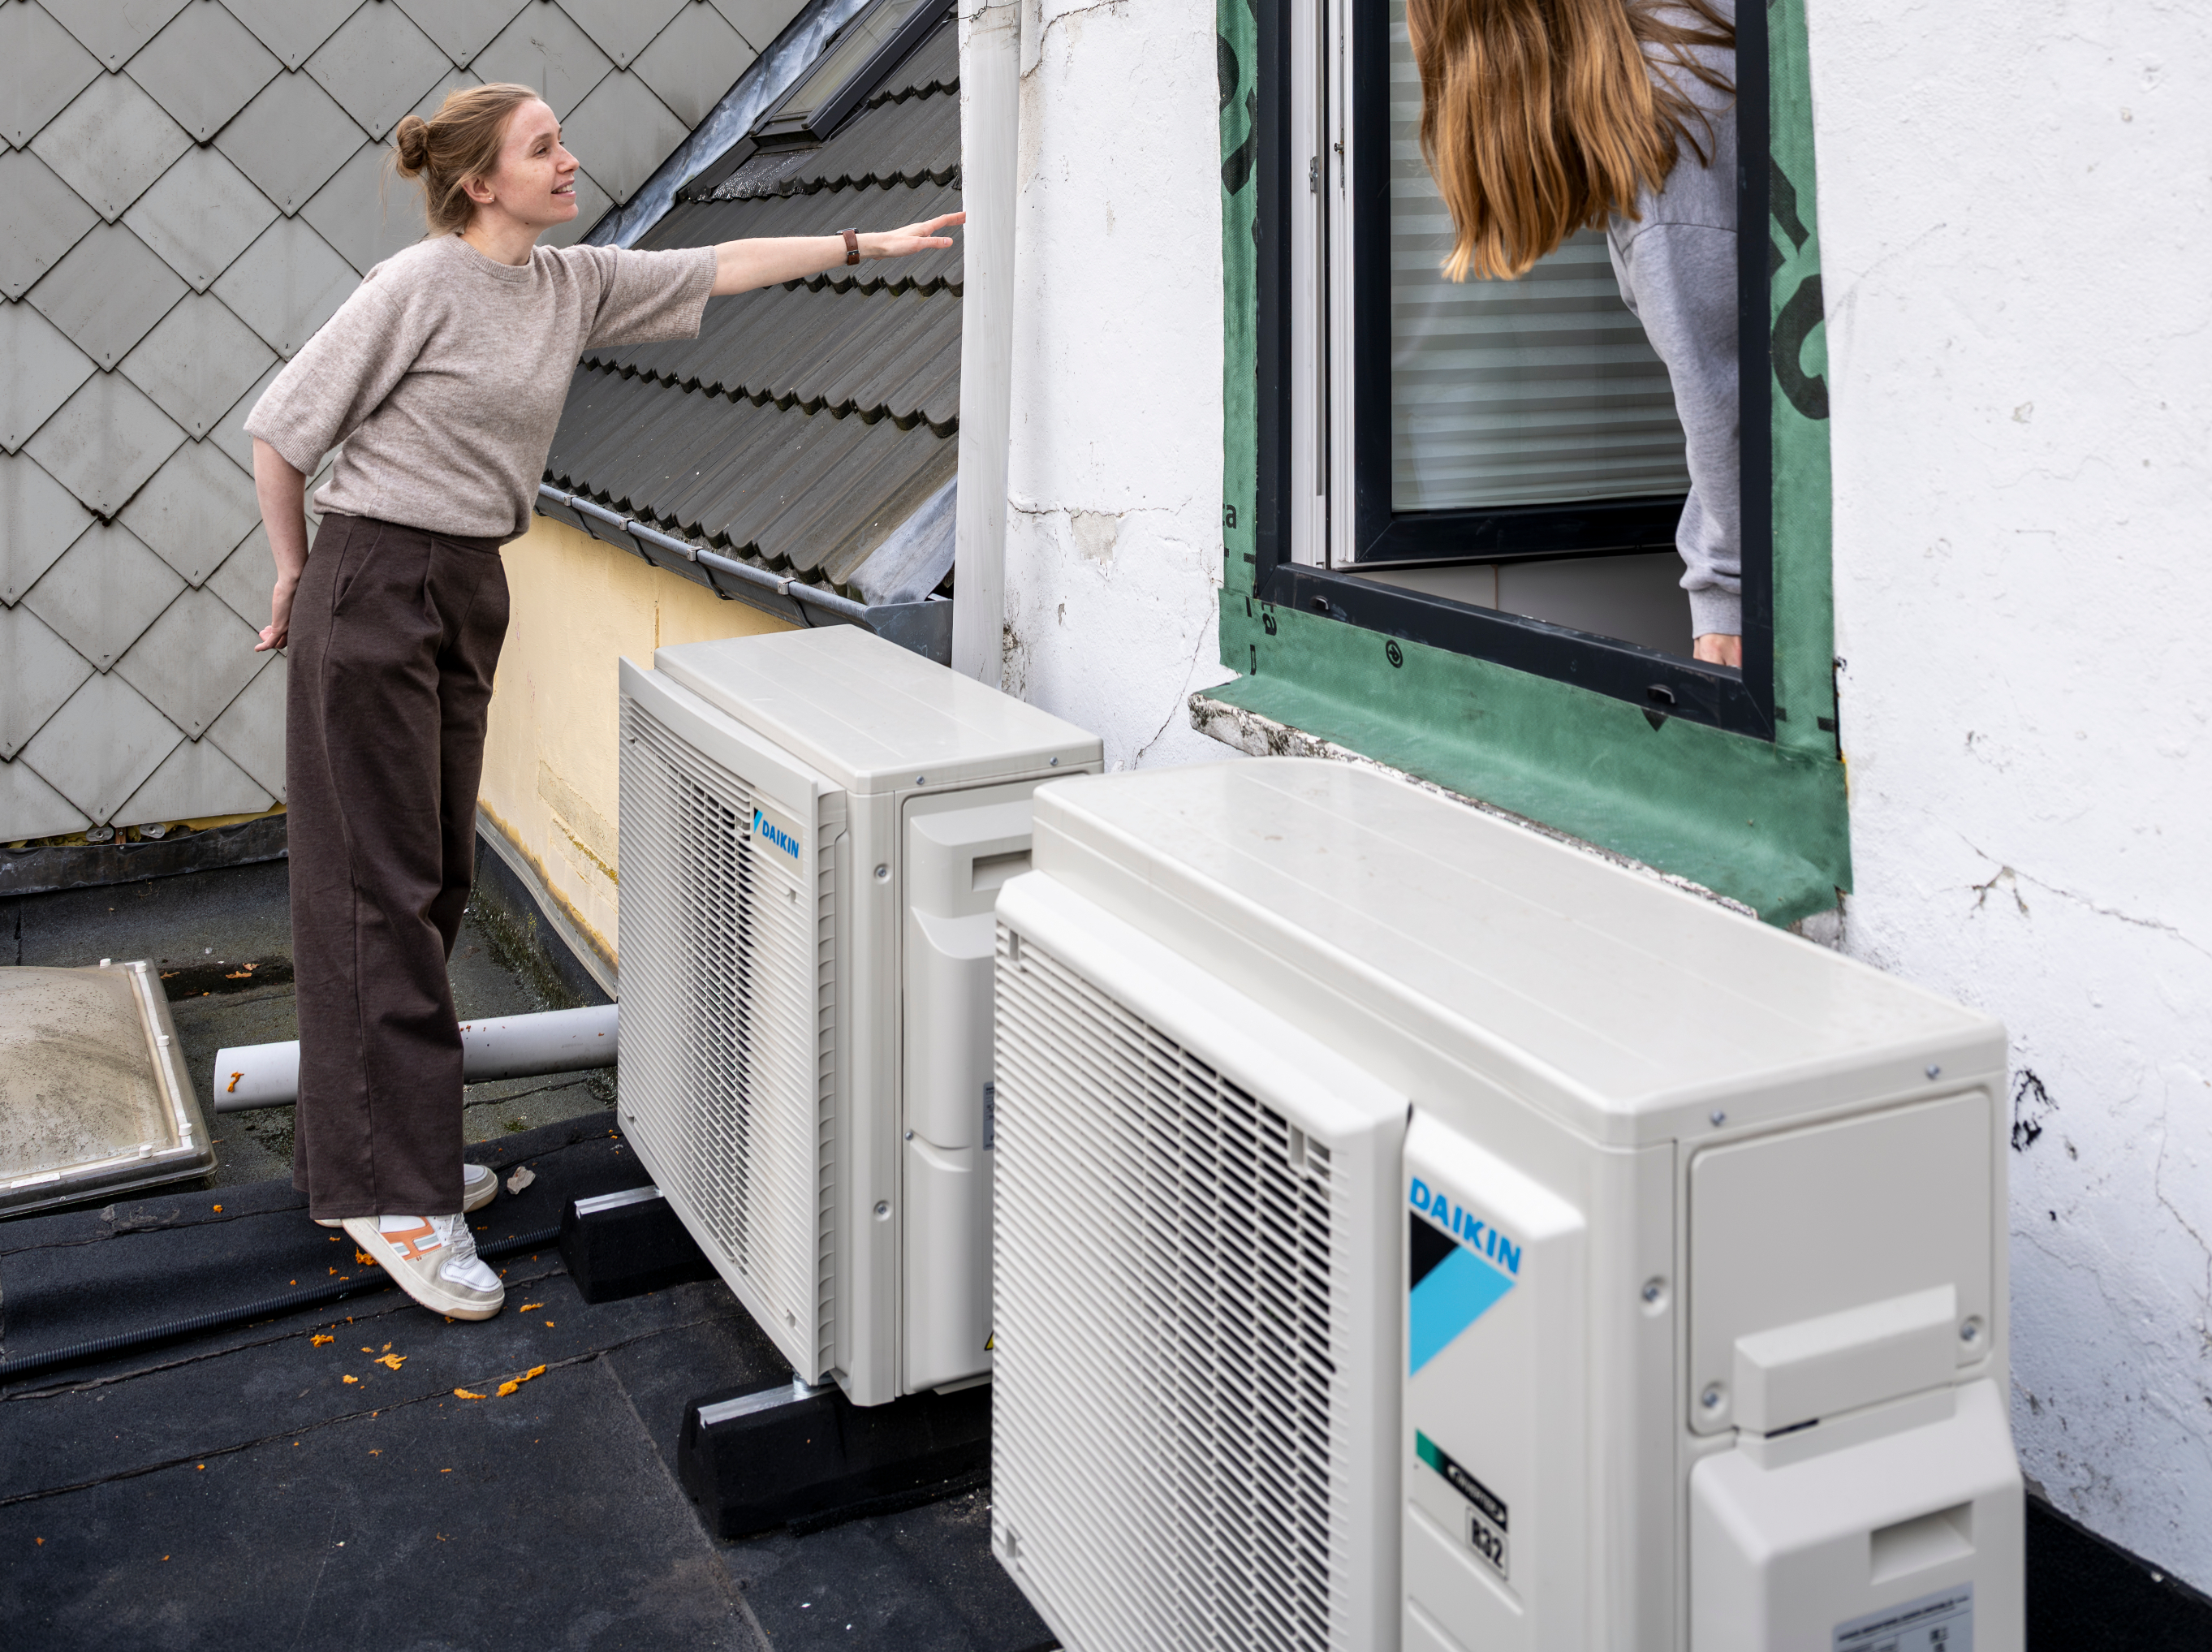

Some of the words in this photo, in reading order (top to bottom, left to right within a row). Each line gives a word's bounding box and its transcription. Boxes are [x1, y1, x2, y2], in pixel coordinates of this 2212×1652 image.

[761, 819, 800, 860] DAIKIN
[1409, 1175, 1521, 1275] DAIKIN
[1472, 1516, 1503, 1569] R32
